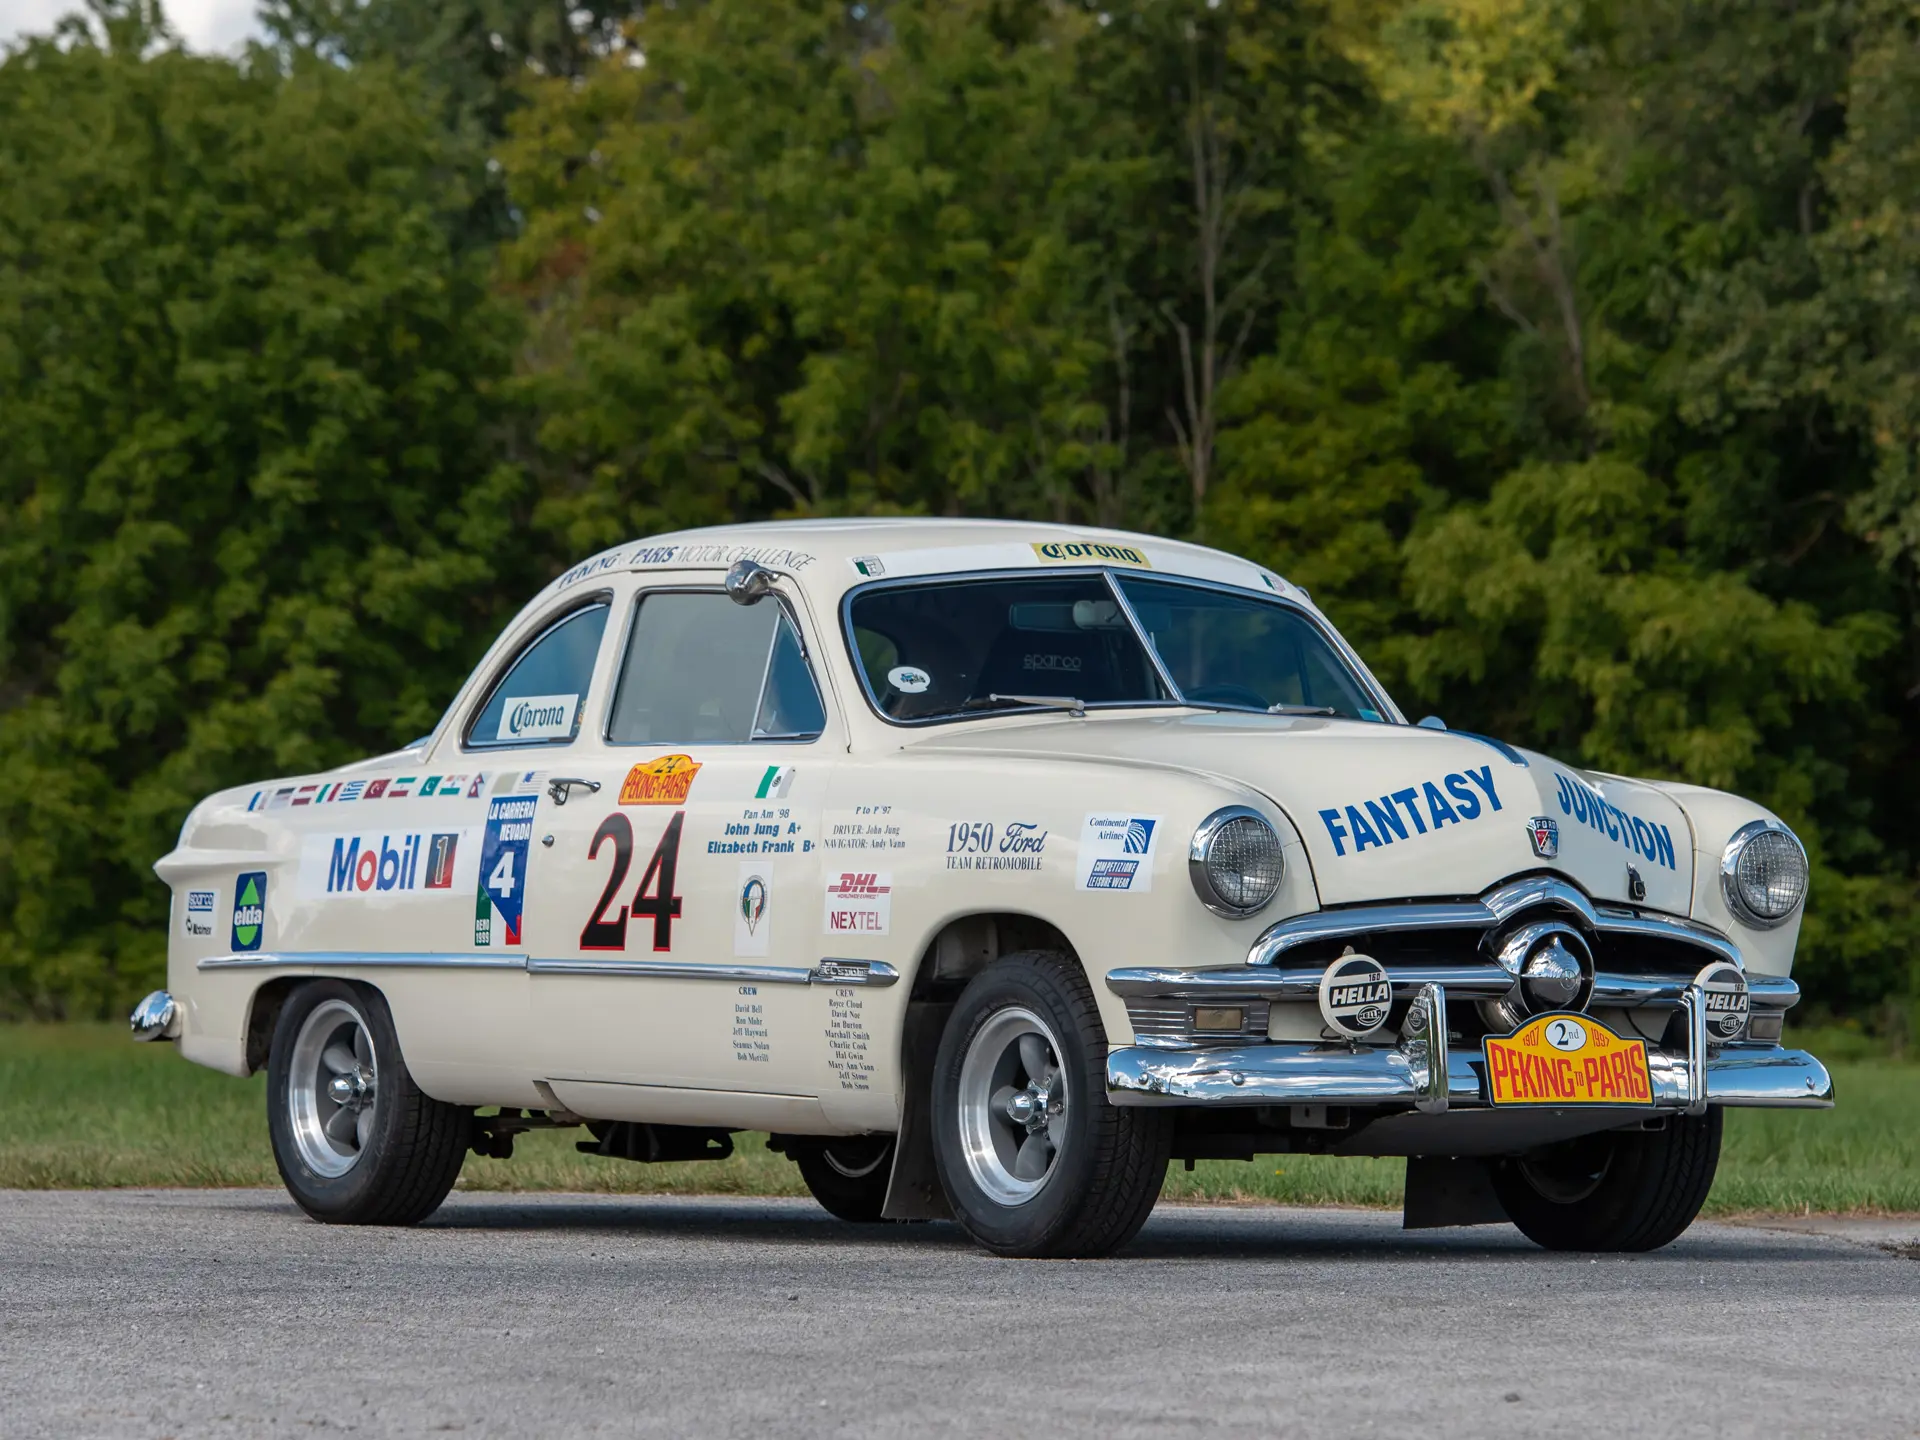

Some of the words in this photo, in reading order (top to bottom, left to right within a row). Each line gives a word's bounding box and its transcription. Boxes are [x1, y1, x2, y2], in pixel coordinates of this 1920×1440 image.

[630, 546, 679, 564] PARIS
[1041, 543, 1142, 564] Corona
[1023, 654, 1082, 671] sparco
[510, 702, 564, 737] Corona
[654, 757, 684, 774] 24
[488, 803, 498, 820] LA
[499, 801, 535, 820] CARRERA
[744, 809, 758, 819] Pan
[760, 810, 774, 819] Am
[1318, 765, 1502, 857] FANTASY
[1090, 817, 1129, 828] Continental
[1535, 820, 1556, 830] FORD
[1553, 772, 1676, 870] JUNCTION
[499, 823, 531, 841] NEVADA
[725, 823, 750, 835] John
[754, 823, 780, 837] Jung
[787, 823, 802, 835] A+
[866, 825, 882, 835] John
[884, 825, 901, 837] Jung
[1098, 831, 1124, 841] Airlines
[871, 839, 886, 850] Andy
[946, 823, 993, 853] 1950
[1000, 823, 1047, 853] Ford
[708, 840, 758, 853] Elizabeth
[762, 840, 794, 853] Frank
[803, 840, 816, 853] B+
[327, 835, 421, 892] Mobil
[947, 856, 971, 870] TEAM
[1093, 861, 1138, 876] COMPETIZIONE
[489, 851, 516, 898] 4
[579, 811, 686, 951] 24
[839, 873, 878, 893] DHL
[1088, 876, 1112, 888] LEISURE
[1112, 877, 1130, 889] WEAR
[234, 905, 263, 926] elda
[831, 911, 883, 930] NEXTEL
[476, 919, 490, 931] RENO
[476, 932, 490, 943] 1999
[1369, 972, 1381, 982] 160
[738, 986, 757, 995] CREW
[836, 989, 854, 997] CREW
[1332, 983, 1389, 1006] HELLA
[735, 1004, 749, 1013] David
[829, 999, 844, 1009] Royce
[1705, 994, 1748, 1010] HELLA
[832, 1010, 847, 1018] David
[1359, 1009, 1382, 1019] HELLA
[832, 1020, 840, 1028] Ian
[825, 1030, 851, 1039] Marshall
[853, 1031, 870, 1040] Smith
[1523, 1025, 1540, 1047] 1907
[1554, 1022, 1580, 1046] 2nd
[1591, 1027, 1610, 1047] 1997
[830, 1040, 850, 1049] Charlie
[853, 1042, 867, 1050] Cook
[829, 1061, 844, 1070] Mary
[1490, 1042, 1576, 1098] PEKING
[1574, 1071, 1584, 1087] TO
[1583, 1043, 1649, 1099] PARIS
